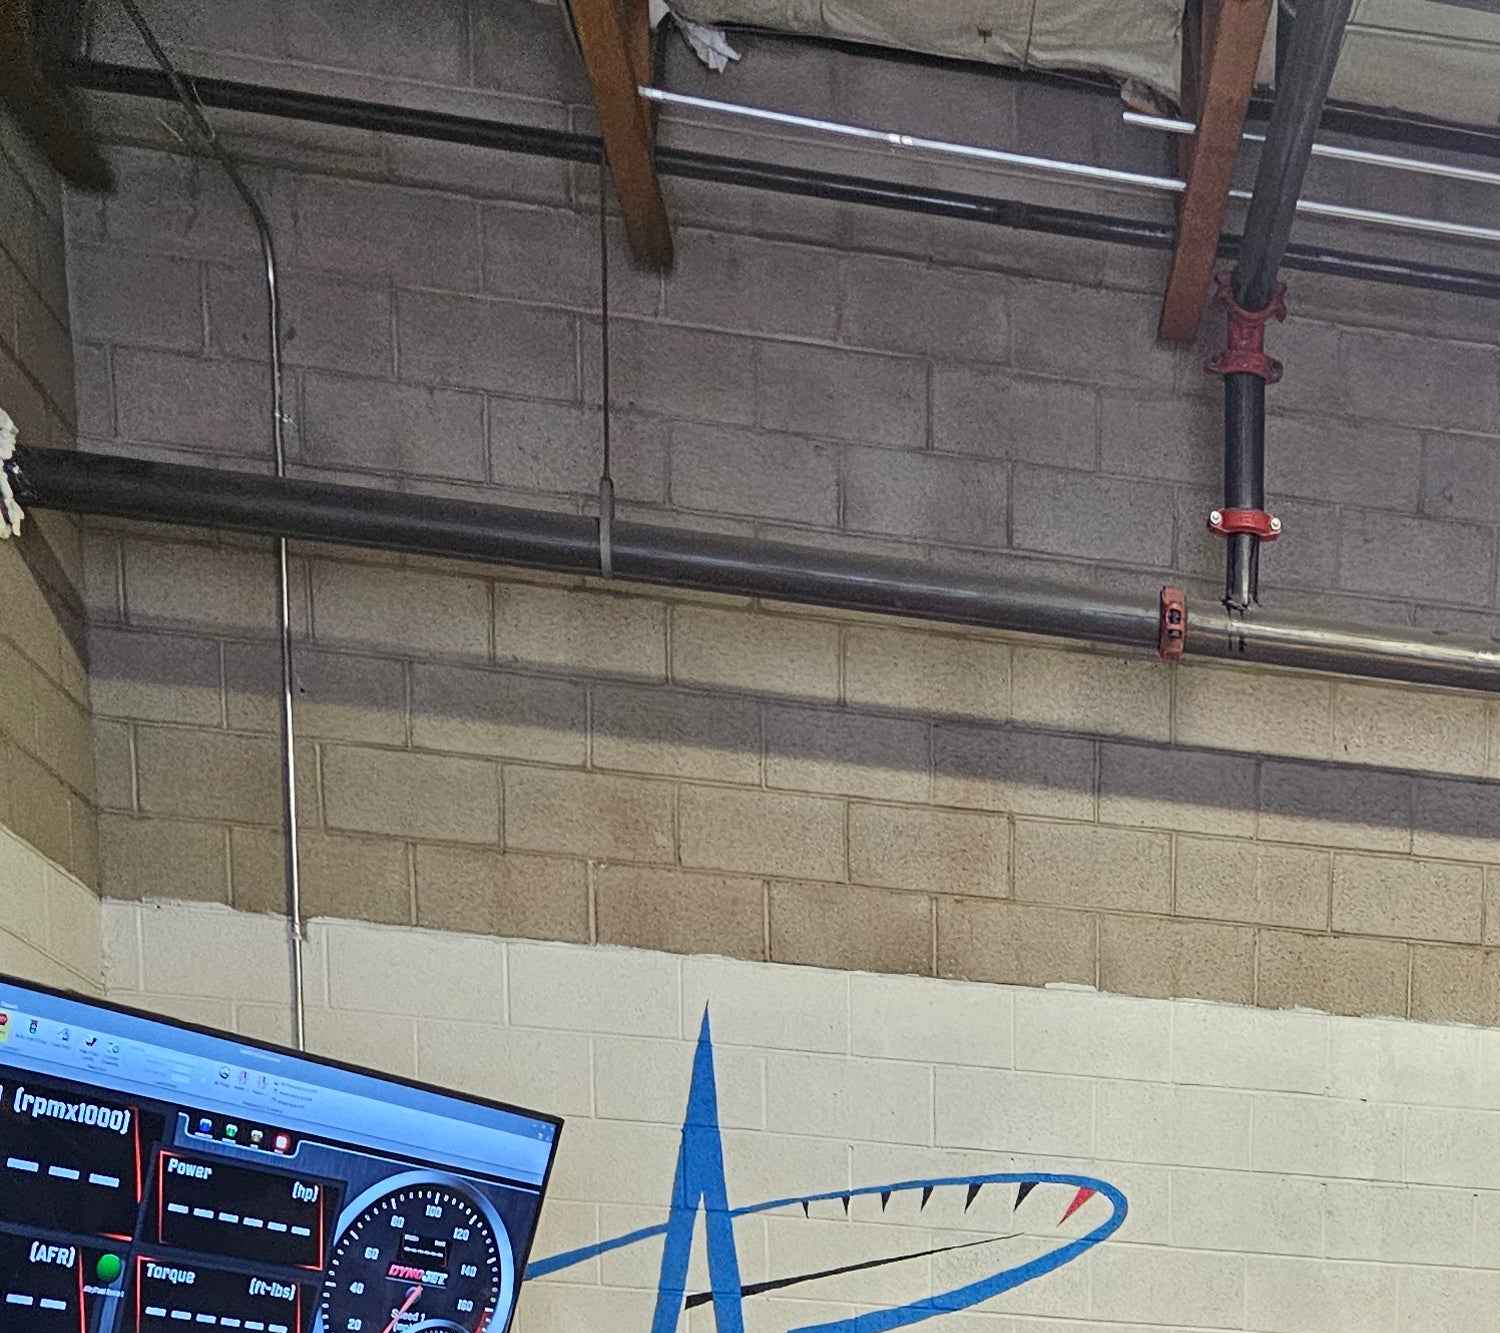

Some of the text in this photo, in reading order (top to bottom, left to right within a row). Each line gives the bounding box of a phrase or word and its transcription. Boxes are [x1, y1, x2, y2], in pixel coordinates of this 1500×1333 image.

[13, 1086, 131, 1135] (rpmx1000)
[168, 1158, 212, 1180] Power
[292, 1181, 319, 1203] (hp)
[29, 1241, 76, 1268] (AFR)
[147, 1263, 196, 1285] Torque
